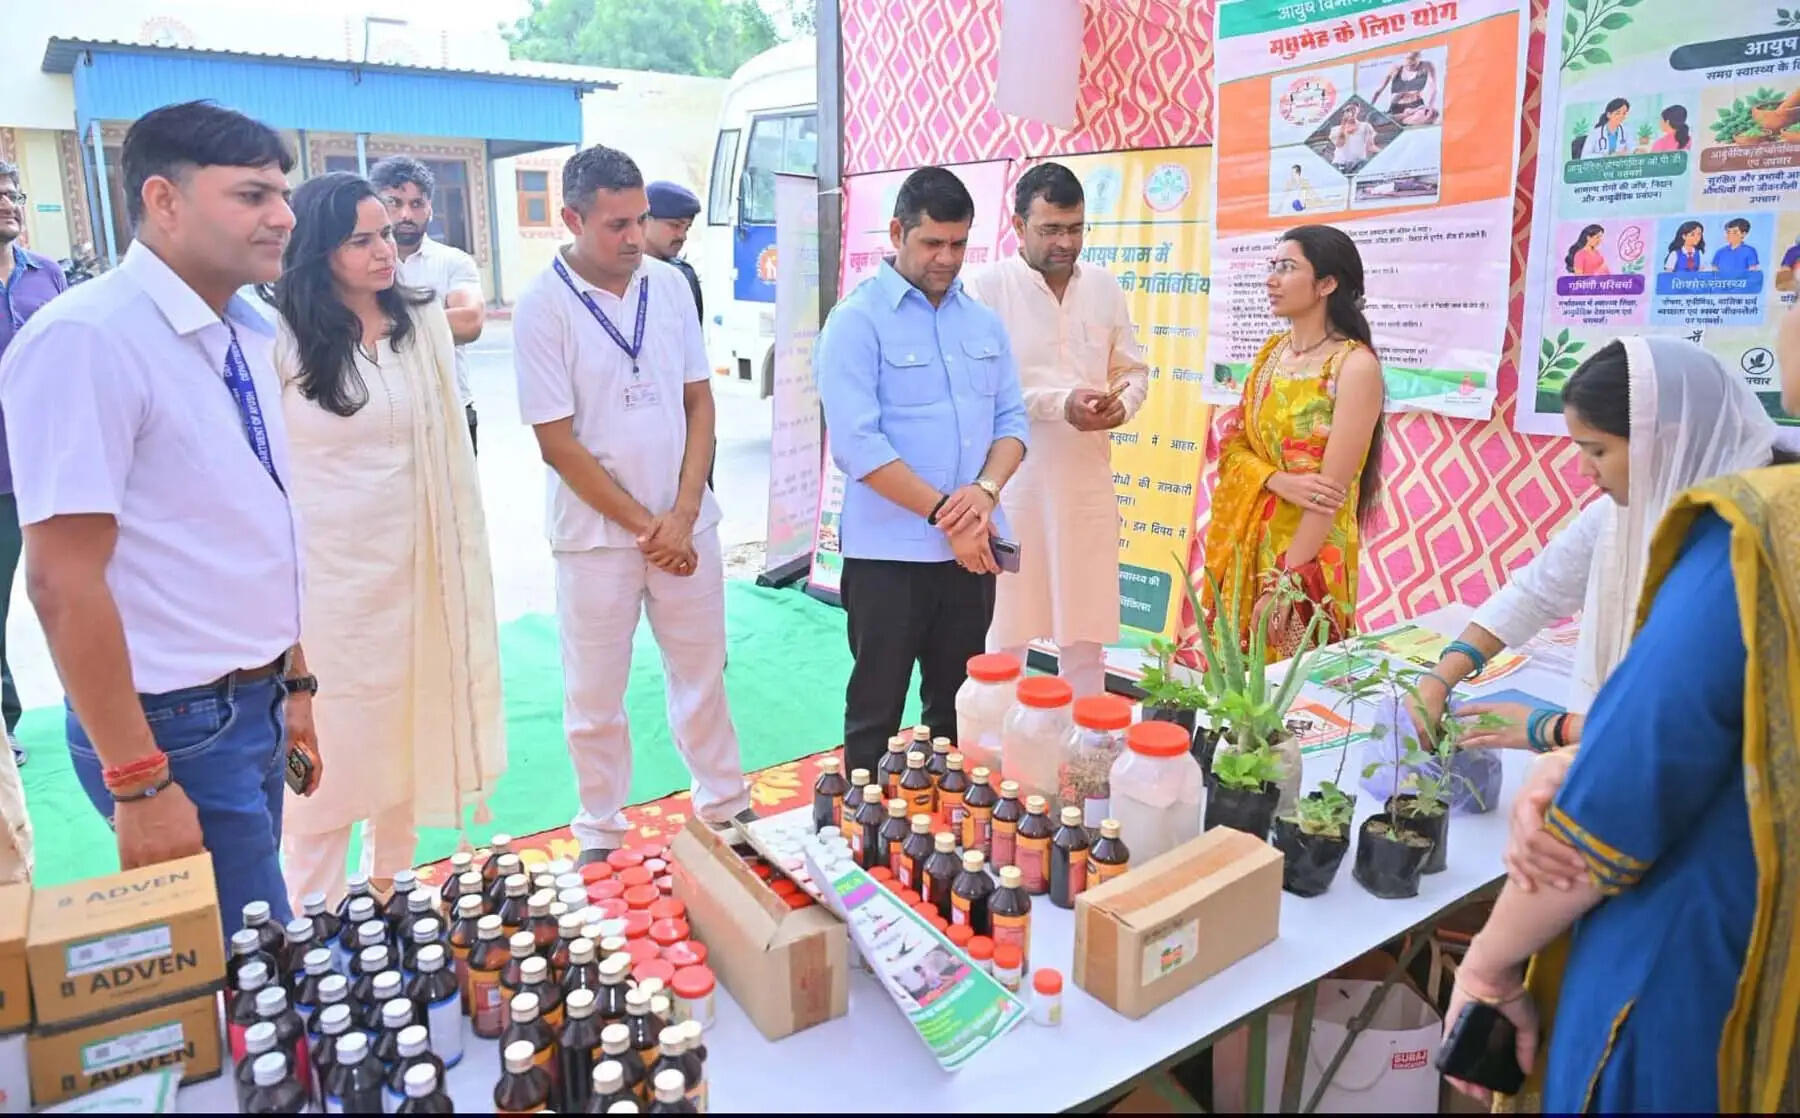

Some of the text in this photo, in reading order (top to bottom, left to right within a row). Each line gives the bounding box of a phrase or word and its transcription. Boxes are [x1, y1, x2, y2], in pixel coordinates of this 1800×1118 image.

[1269, 1, 1458, 60] मधुमेह के लिए योग
[1744, 36, 1800, 57] आयुष
[1736, 64, 1775, 77] स्वास्थ्य
[1778, 60, 1789, 72] के
[1121, 245, 1152, 263] ग्राम
[1155, 241, 1173, 264] में
[1139, 271, 1210, 295] गतिविधिय
[1138, 475, 1151, 489] की
[1178, 527, 1187, 540] में
[86, 870, 190, 904] ADVEN
[90, 950, 198, 994] ADVEN
